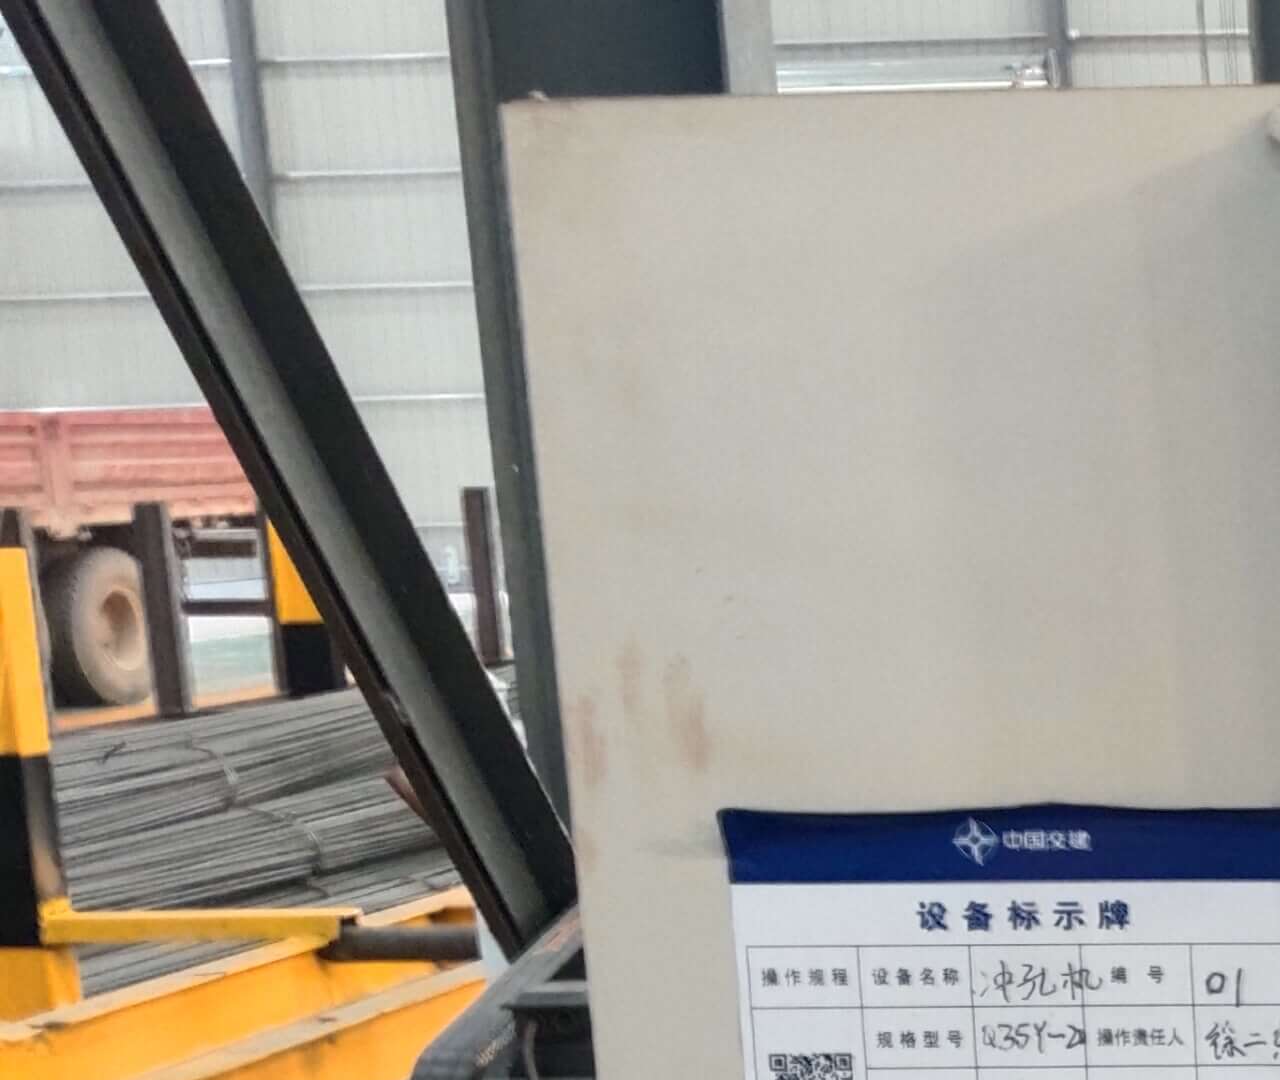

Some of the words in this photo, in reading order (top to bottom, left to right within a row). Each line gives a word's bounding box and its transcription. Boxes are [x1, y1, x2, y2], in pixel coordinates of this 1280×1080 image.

[1002, 829, 1092, 851] 中国交建
[917, 900, 1129, 931] 设备标示牌
[761, 967, 849, 987] 操作规程
[871, 967, 960, 987] 设备名称
[1111, 965, 1164, 985] 编号
[1205, 967, 1243, 1007] 01
[877, 1030, 962, 1049] 规格型号
[1097, 1028, 1184, 1047] 操作责任人
